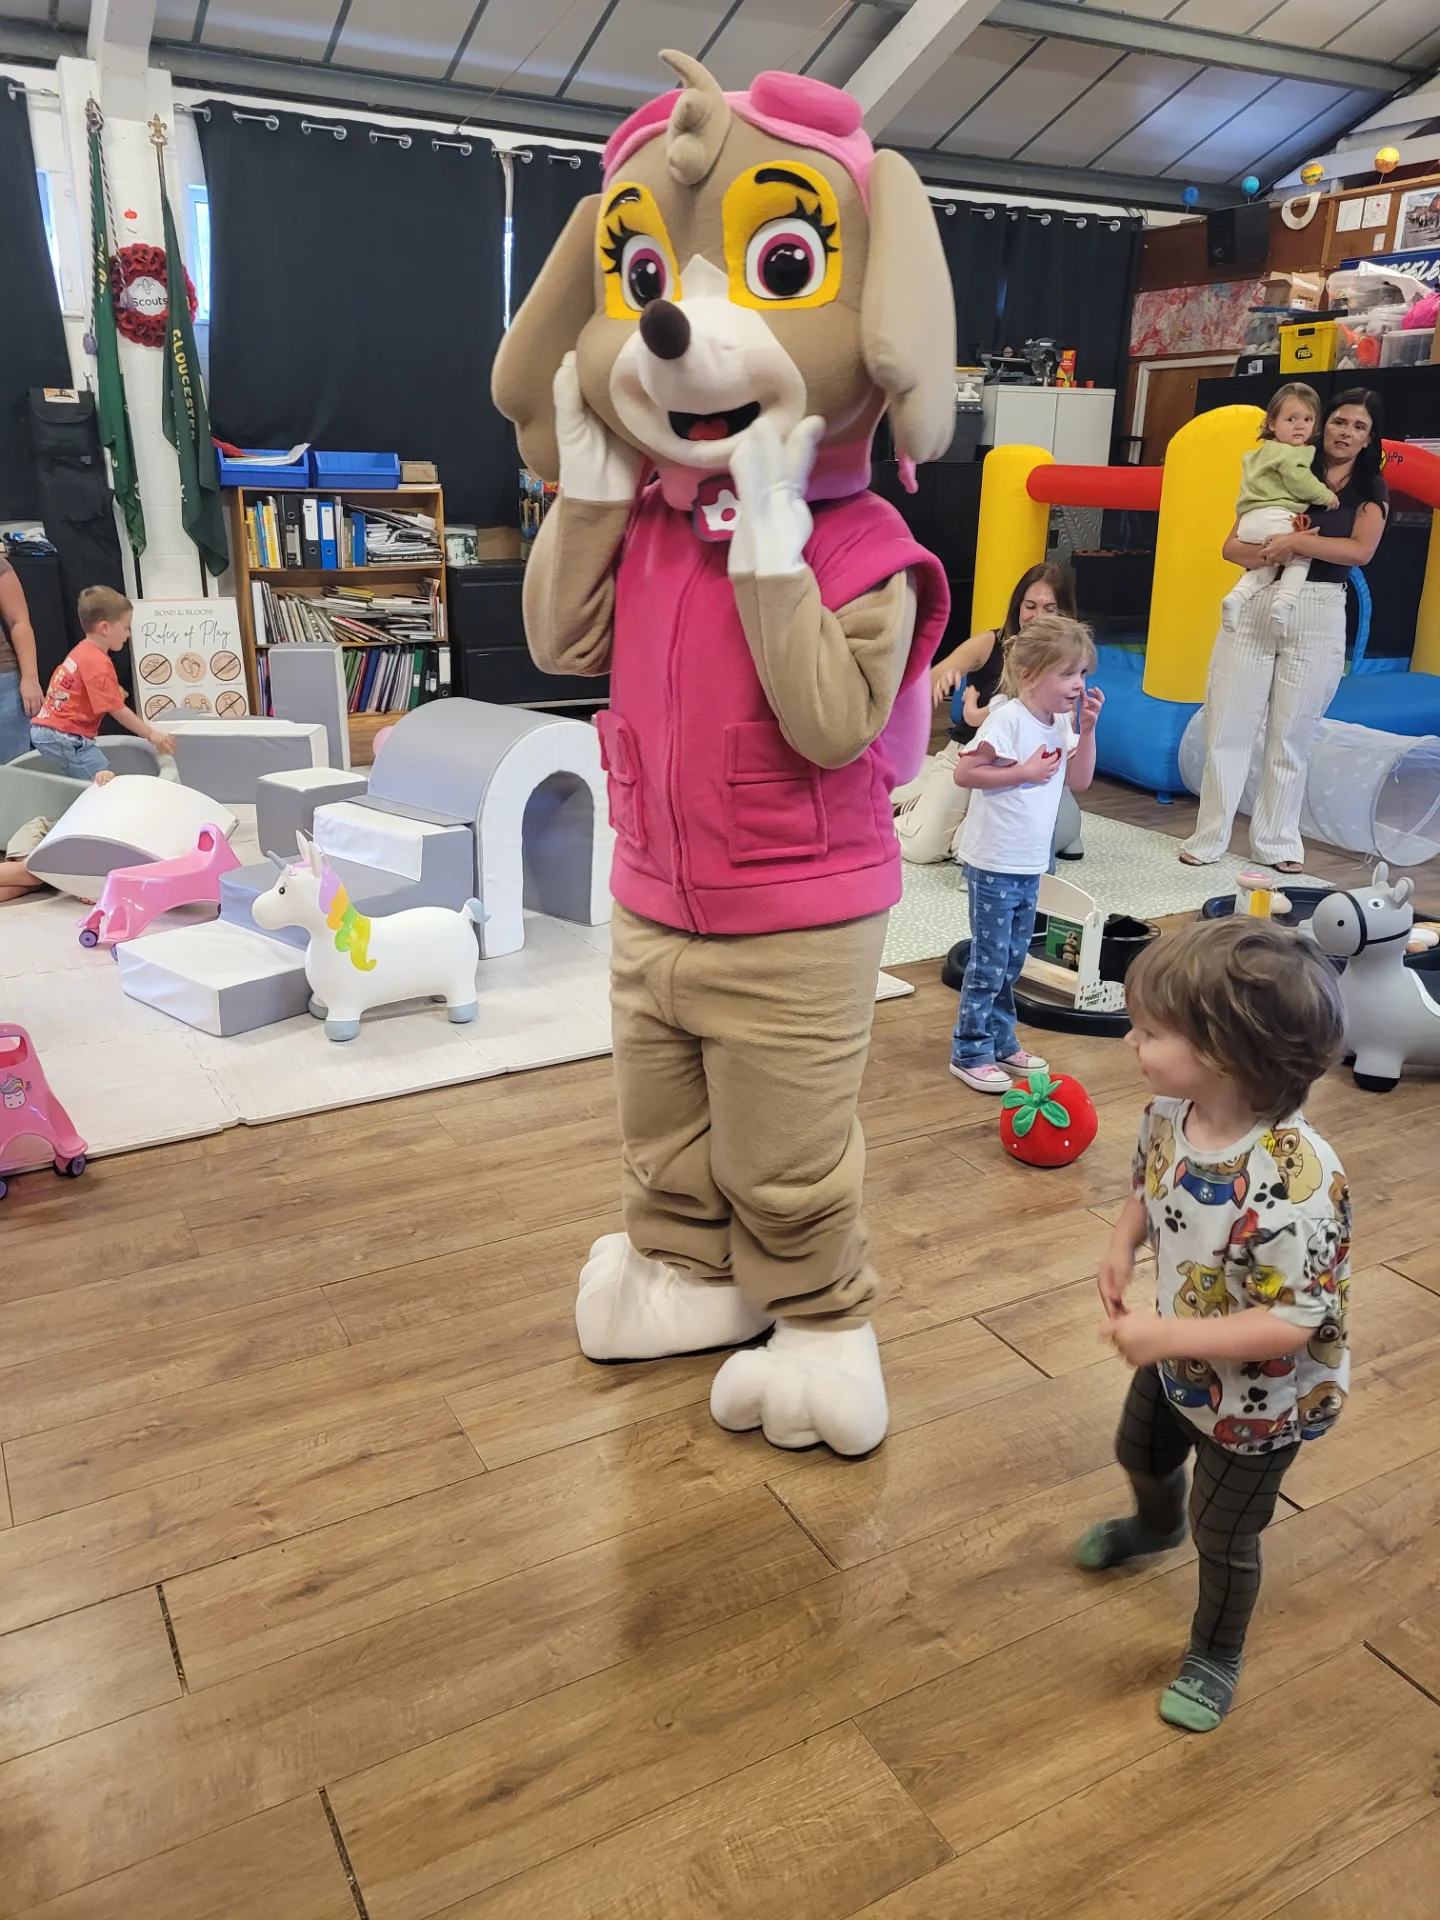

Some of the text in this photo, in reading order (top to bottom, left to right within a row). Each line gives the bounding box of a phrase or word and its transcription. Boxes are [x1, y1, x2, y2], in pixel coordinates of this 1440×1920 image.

[132, 297, 169, 307] Scouts
[154, 608, 177, 617] BOND
[185, 608, 213, 616] BLOOM
[141, 619, 232, 649] Rules of Play
